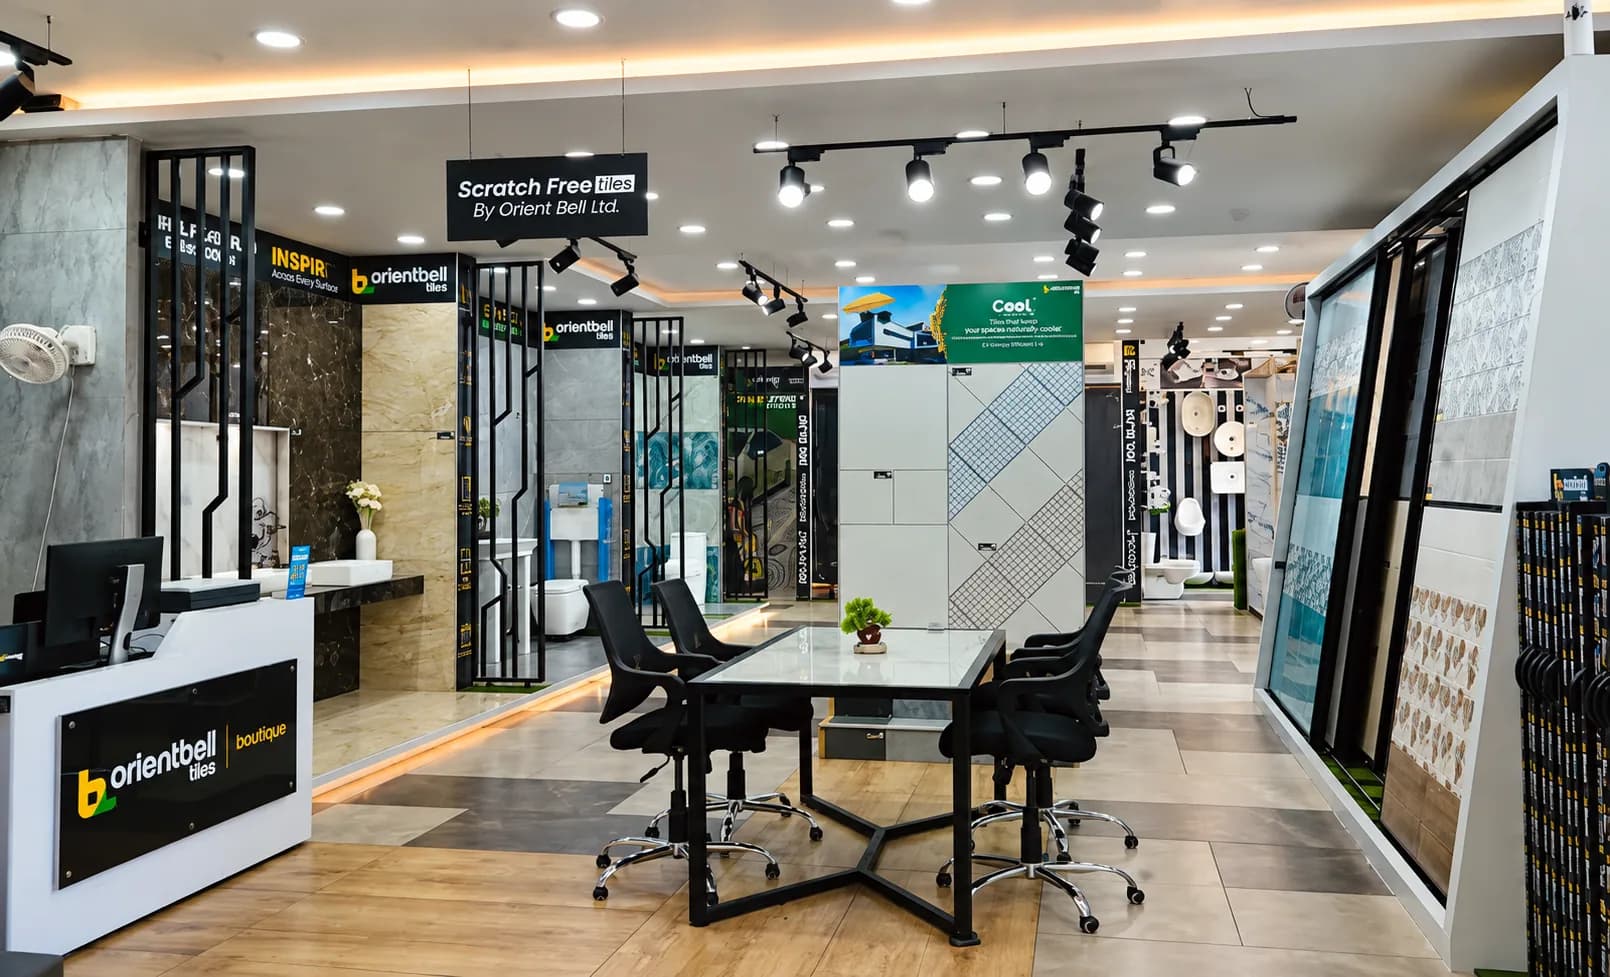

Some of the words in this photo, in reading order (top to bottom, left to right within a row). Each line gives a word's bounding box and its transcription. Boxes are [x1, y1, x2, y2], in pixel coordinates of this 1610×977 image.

[458, 178, 540, 198] Scratch
[546, 177, 592, 195] Free
[598, 175, 632, 191] tiles
[473, 202, 495, 221] By
[499, 201, 552, 216] Orient
[556, 199, 587, 215] Bell
[591, 198, 619, 214] Ltd.
[371, 266, 448, 284] orientbell
[425, 282, 448, 293] tiles
[992, 298, 1032, 313] Cool
[555, 319, 614, 333] orientbell
[235, 722, 287, 750] boutique
[110, 729, 217, 789] orientbell
[189, 761, 216, 781] tiles
